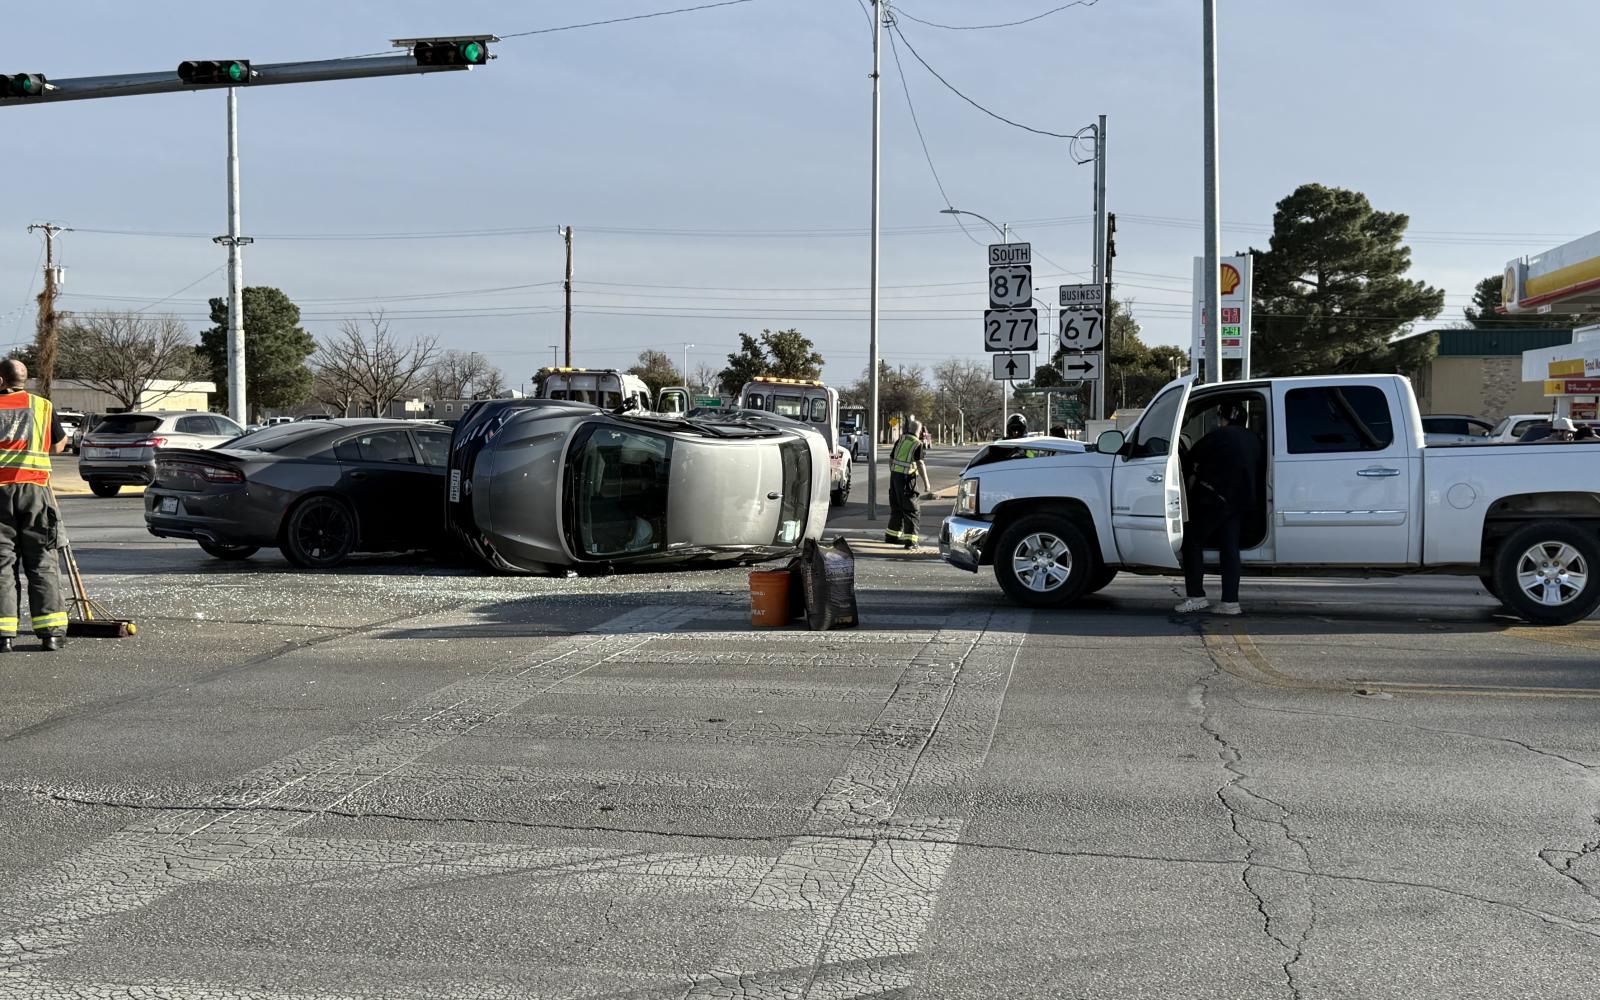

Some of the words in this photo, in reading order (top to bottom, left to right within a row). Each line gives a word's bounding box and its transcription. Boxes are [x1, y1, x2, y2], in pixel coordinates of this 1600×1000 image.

[992, 247, 1028, 262] SOUTH
[993, 274, 1027, 298] 87
[1061, 289, 1101, 301] BUSINESS
[988, 318, 1034, 342] 277
[1064, 317, 1098, 340] 67
